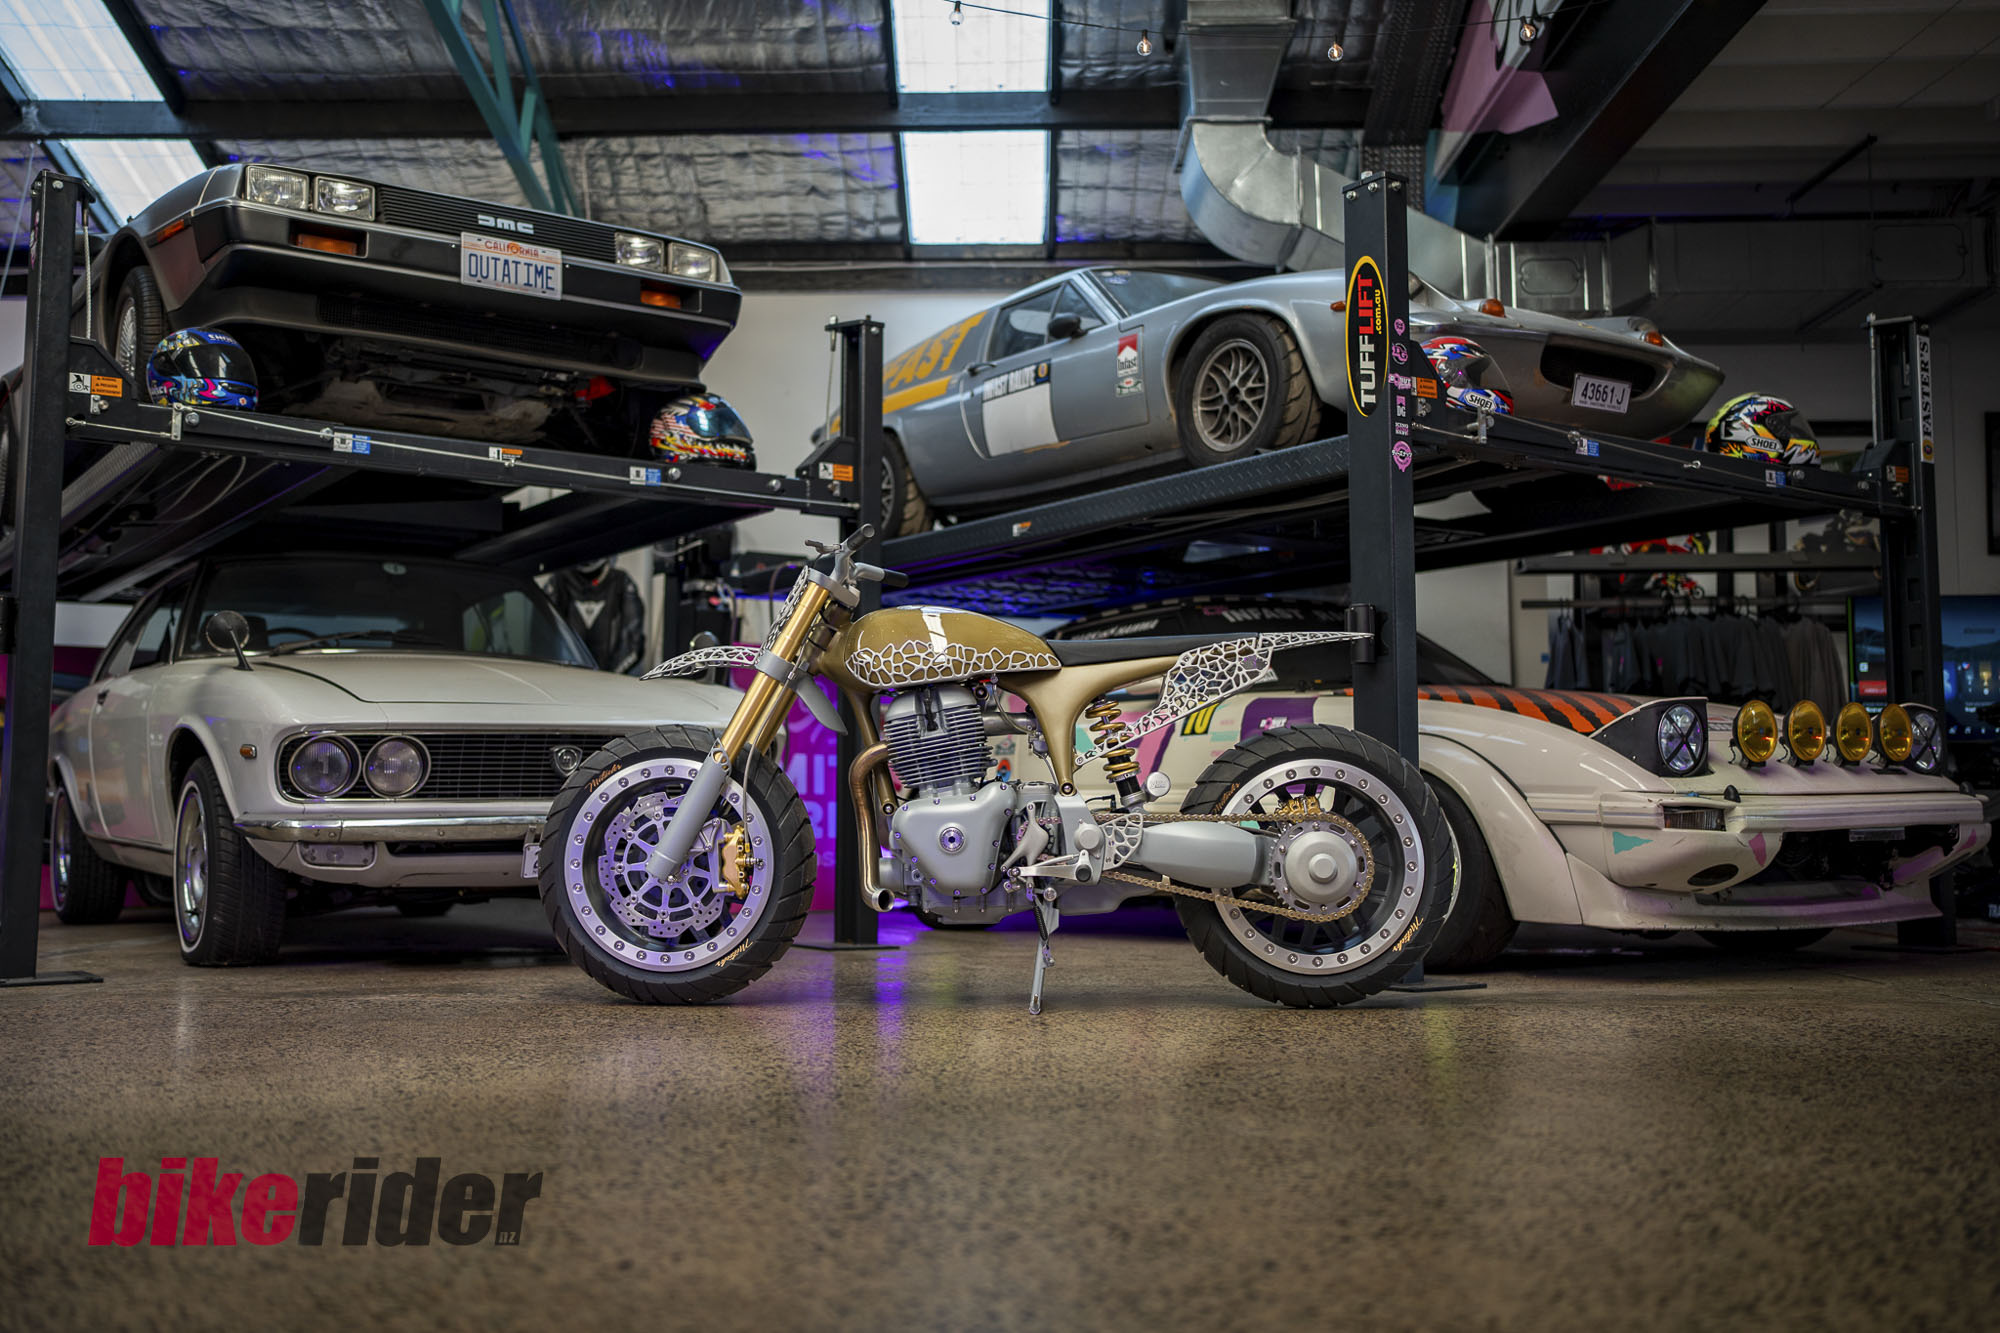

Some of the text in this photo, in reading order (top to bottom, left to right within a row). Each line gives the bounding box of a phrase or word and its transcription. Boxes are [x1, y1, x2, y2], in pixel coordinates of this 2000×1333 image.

[484, 240, 540, 258] CALIFORNIA
[468, 253, 555, 291] OUTATIME
[1374, 288, 1382, 335] .com.au
[1357, 273, 1377, 408] TUFFLIFT
[1469, 394, 1493, 411] SHOEI
[1919, 341, 1933, 437] FASTER'S
[1751, 438, 1777, 451] SHOEI
